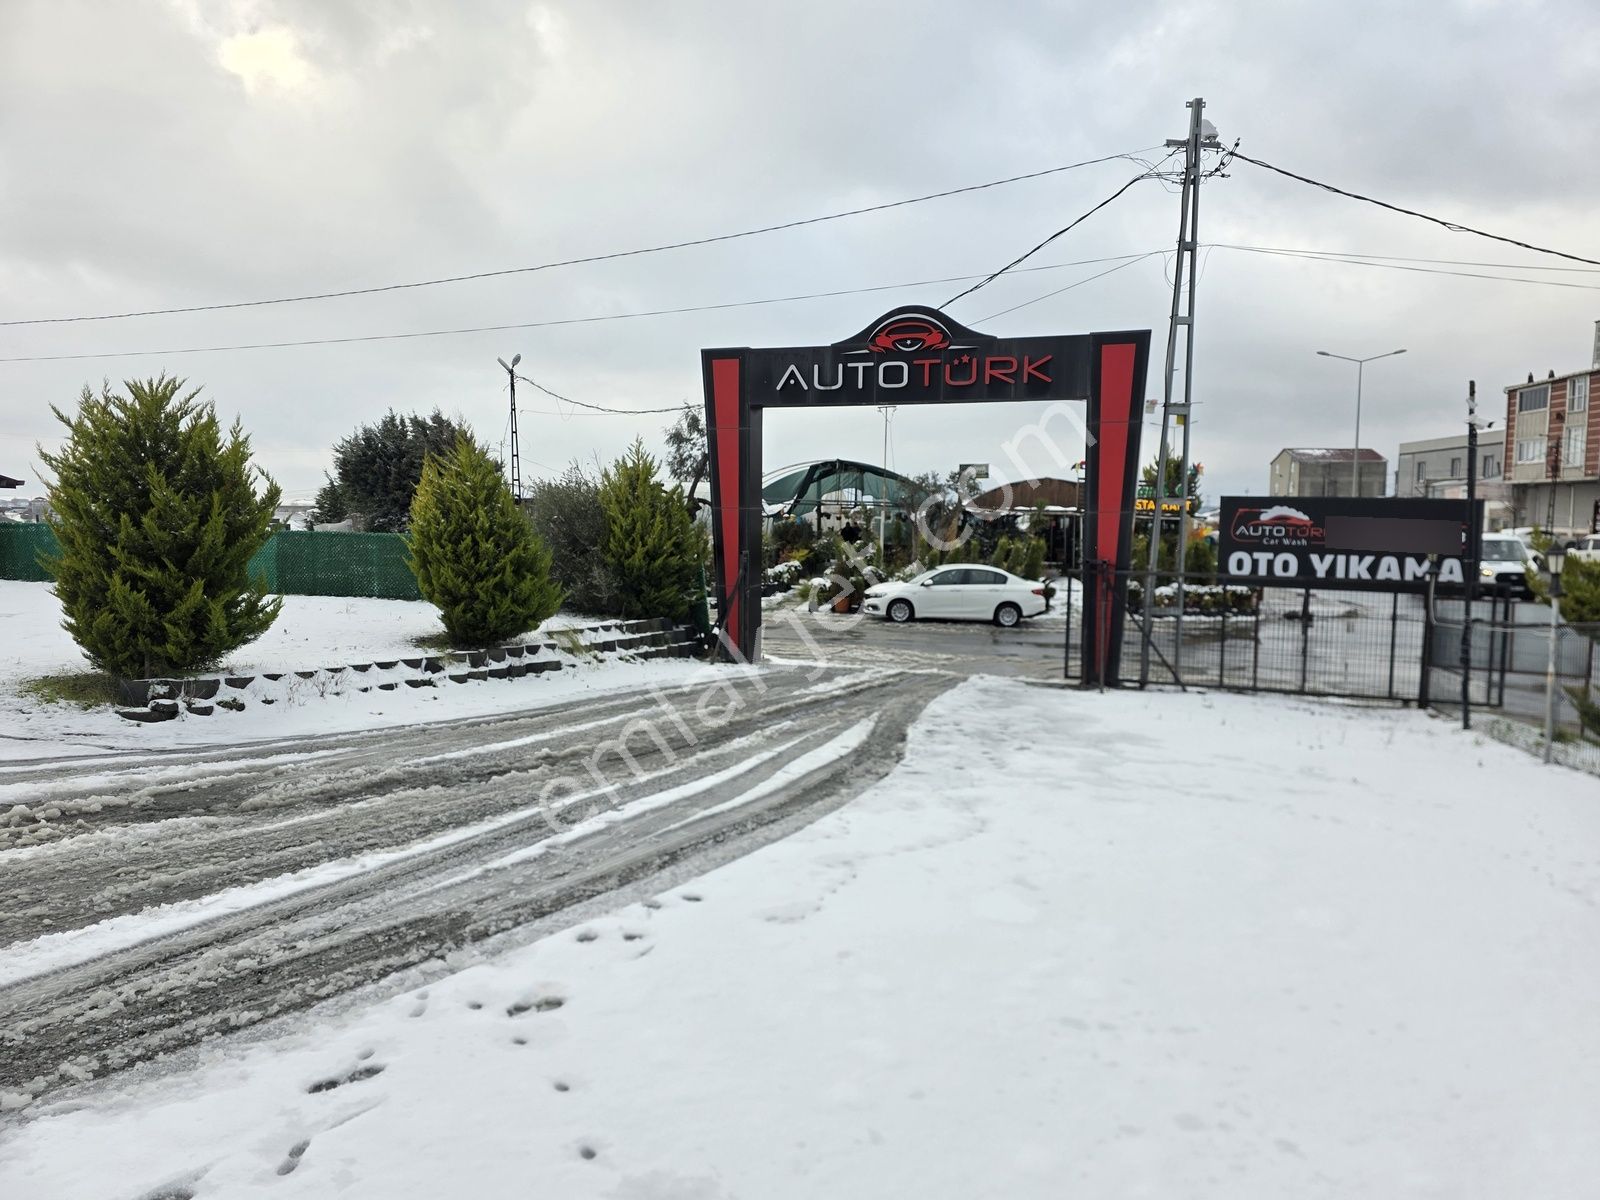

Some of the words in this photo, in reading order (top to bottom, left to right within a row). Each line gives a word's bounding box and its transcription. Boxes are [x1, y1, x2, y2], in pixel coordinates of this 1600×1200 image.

[776, 354, 1053, 391] AUTOTÜRK
[1236, 525, 1326, 537] AUTOTÜR
[1283, 538, 1308, 546] Wash
[1228, 550, 1299, 577] OTO
[1309, 553, 1464, 582] YIKAMA
